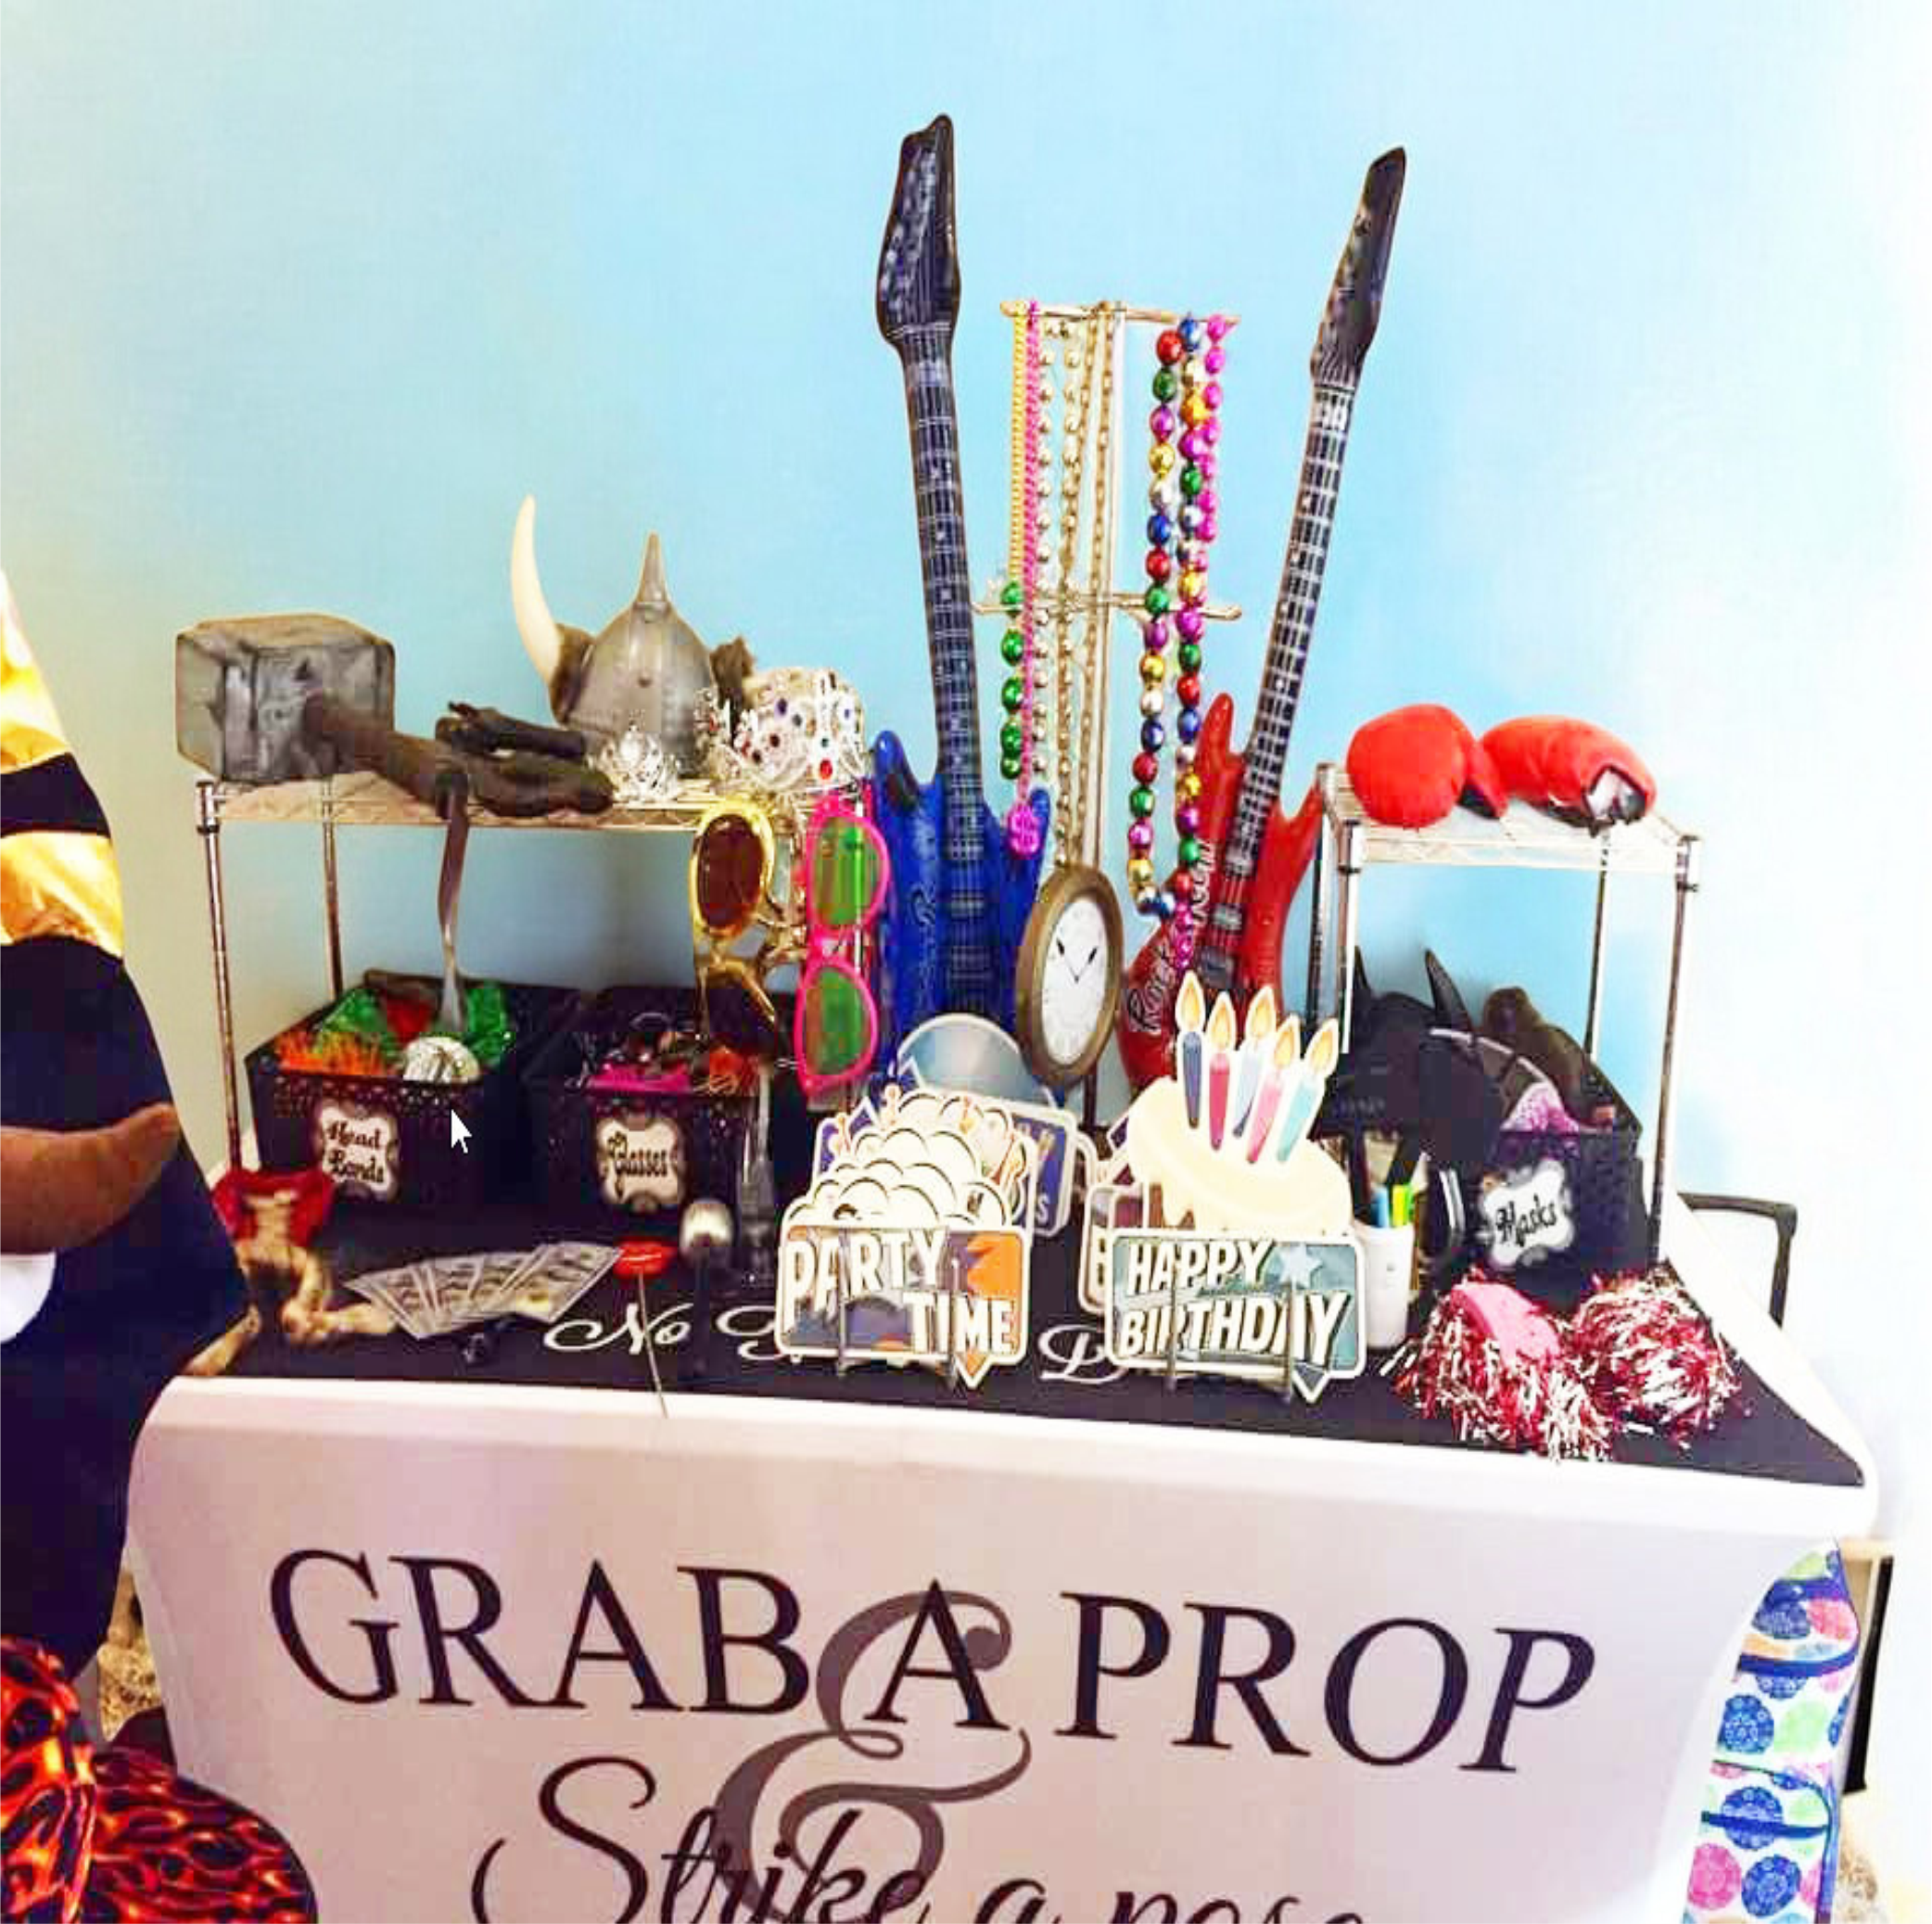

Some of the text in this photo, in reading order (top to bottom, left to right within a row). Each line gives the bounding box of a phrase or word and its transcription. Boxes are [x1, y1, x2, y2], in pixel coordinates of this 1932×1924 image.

[782, 1228, 948, 1335] PARTY
[1126, 1239, 1276, 1296] HAPPY
[902, 1290, 1019, 1356] TIME
[269, 1548, 1596, 1773] GRAB A PROP
